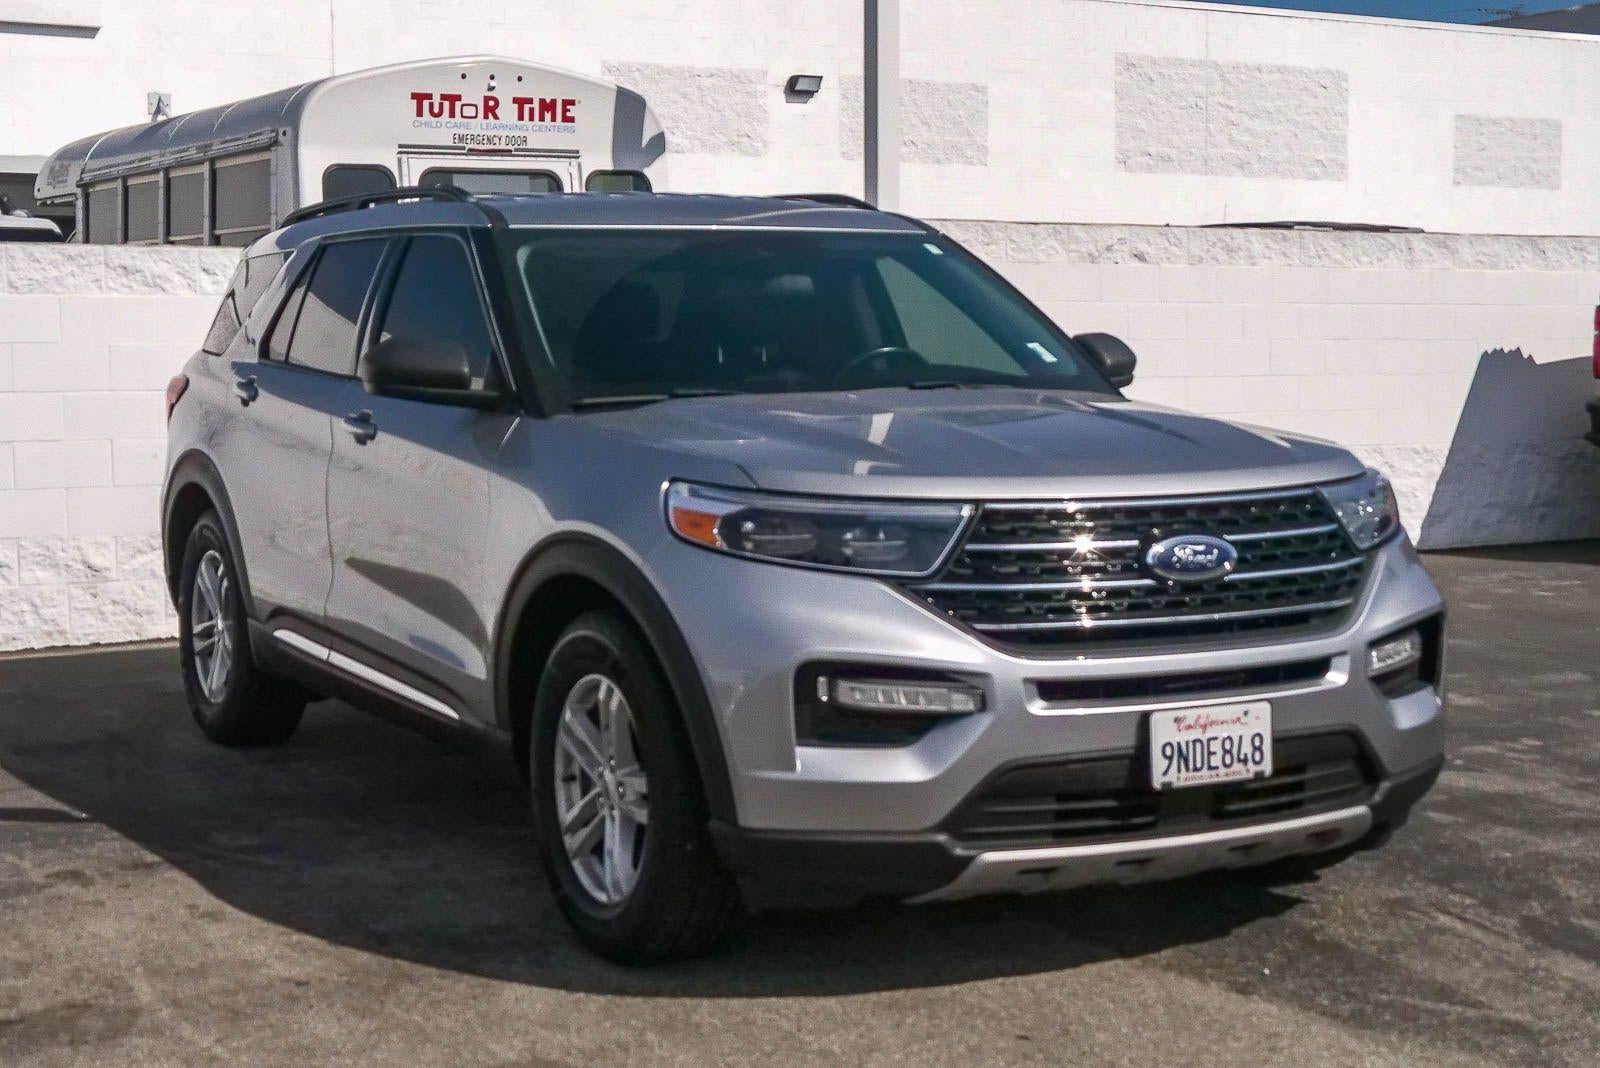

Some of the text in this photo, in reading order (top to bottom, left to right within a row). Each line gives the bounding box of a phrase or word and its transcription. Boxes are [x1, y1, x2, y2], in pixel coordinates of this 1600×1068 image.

[411, 92, 500, 120] TUTOR
[412, 119, 443, 129] CHILD
[445, 120, 472, 130] CARE
[480, 122, 529, 133] LEARNING
[531, 124, 576, 134] CENTERS
[452, 133, 528, 146] EMERGENCY DOOR
[1171, 544, 1219, 564] Ford
[1175, 714, 1246, 735] California
[1161, 732, 1265, 777] 9NDE848
